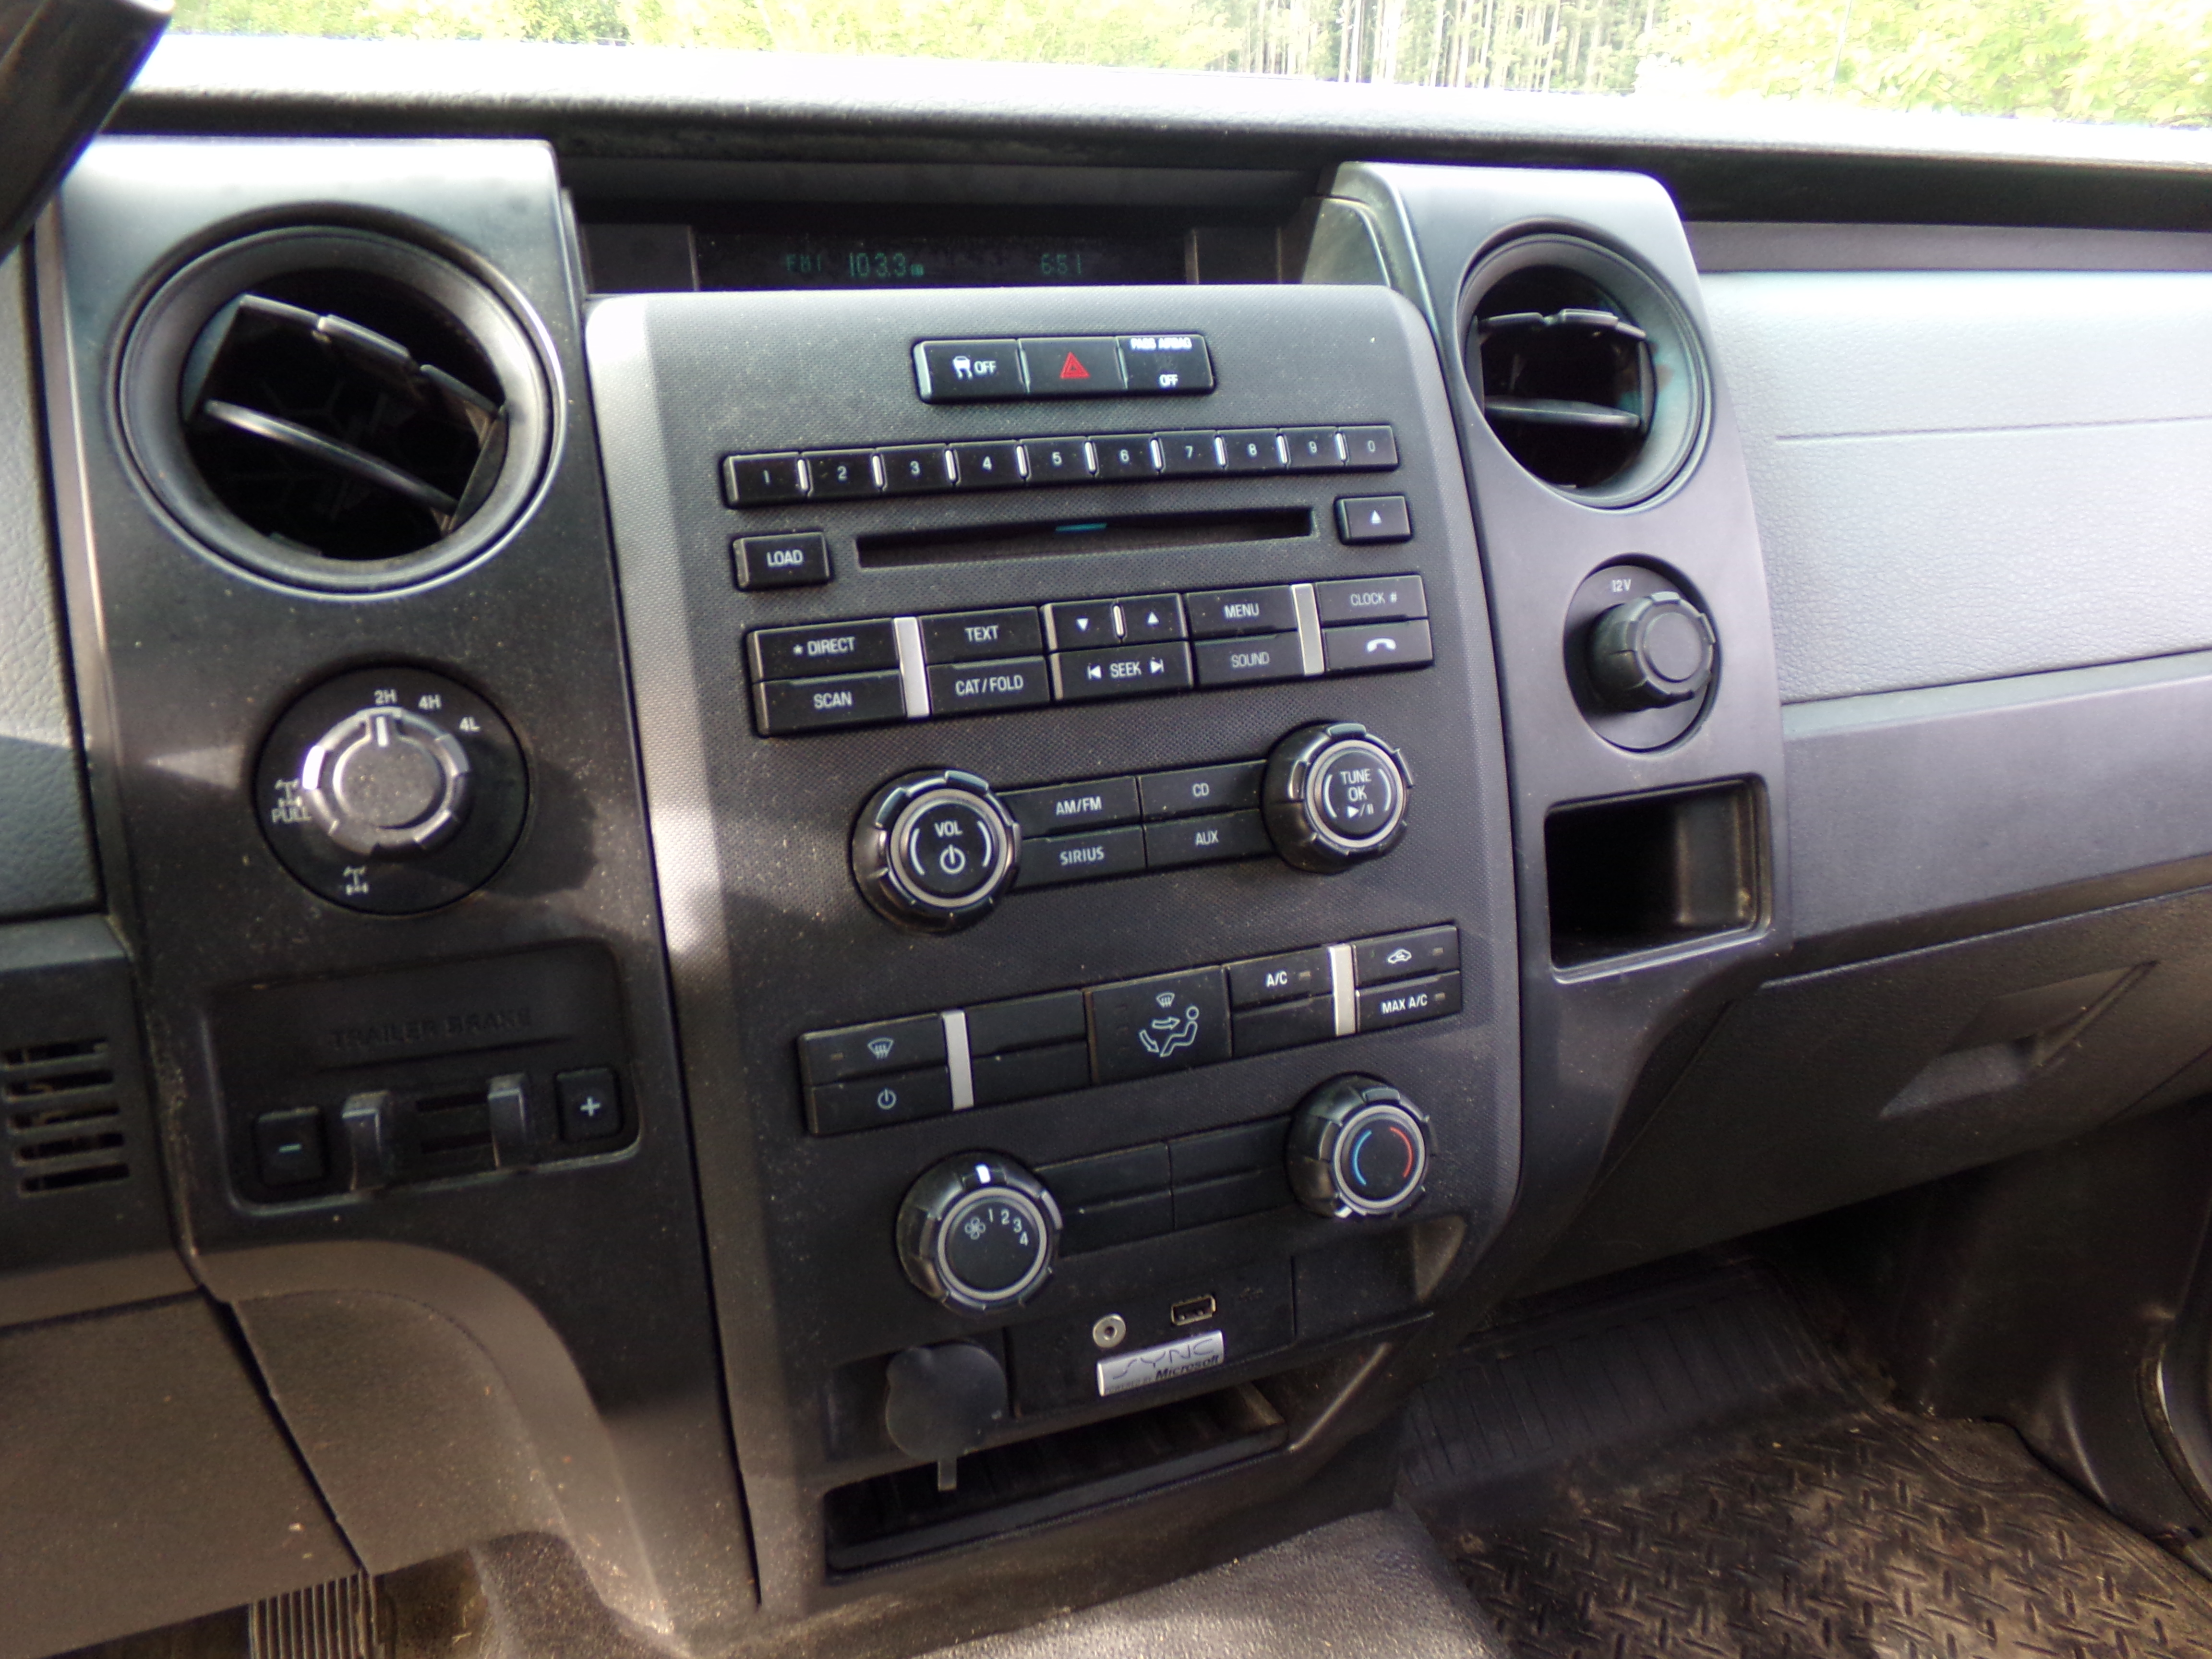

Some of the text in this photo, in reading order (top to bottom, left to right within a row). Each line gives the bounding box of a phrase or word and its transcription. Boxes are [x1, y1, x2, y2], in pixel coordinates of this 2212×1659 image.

[974, 361, 997, 373] OFF
[1159, 374, 1178, 386] OFF
[764, 440, 1376, 483] 1 2 3 4 5 6 7 8 9 0
[767, 549, 804, 567] LOAD
[1612, 579, 1632, 592] 12V
[1350, 592, 1386, 606] CLOCK
[1225, 602, 1260, 619] MENU
[965, 626, 998, 642] TEXT
[807, 637, 855, 656] DIRECT
[1232, 651, 1270, 668] SOUND
[1110, 661, 1142, 678] SEEK
[374, 689, 397, 705] 2H
[418, 694, 442, 710] 4H
[813, 692, 852, 709] SCAN
[459, 716, 481, 733] 4L
[1340, 769, 1372, 784] TUNE
[1192, 783, 1210, 797] CD
[1348, 786, 1368, 801] OK
[271, 805, 312, 824] PULL
[1056, 796, 1102, 816] AM/FM
[934, 819, 963, 837] VOL
[1195, 830, 1219, 846] AUX
[1060, 846, 1105, 866] SIRIUS
[1266, 971, 1288, 988] A/C
[1382, 994, 1428, 1014] MAX A/C
[988, 1207, 1029, 1246] 1 2 3 4
[1112, 1338, 1214, 1380] SYNC
[1155, 1355, 1220, 1380] Microsoft
